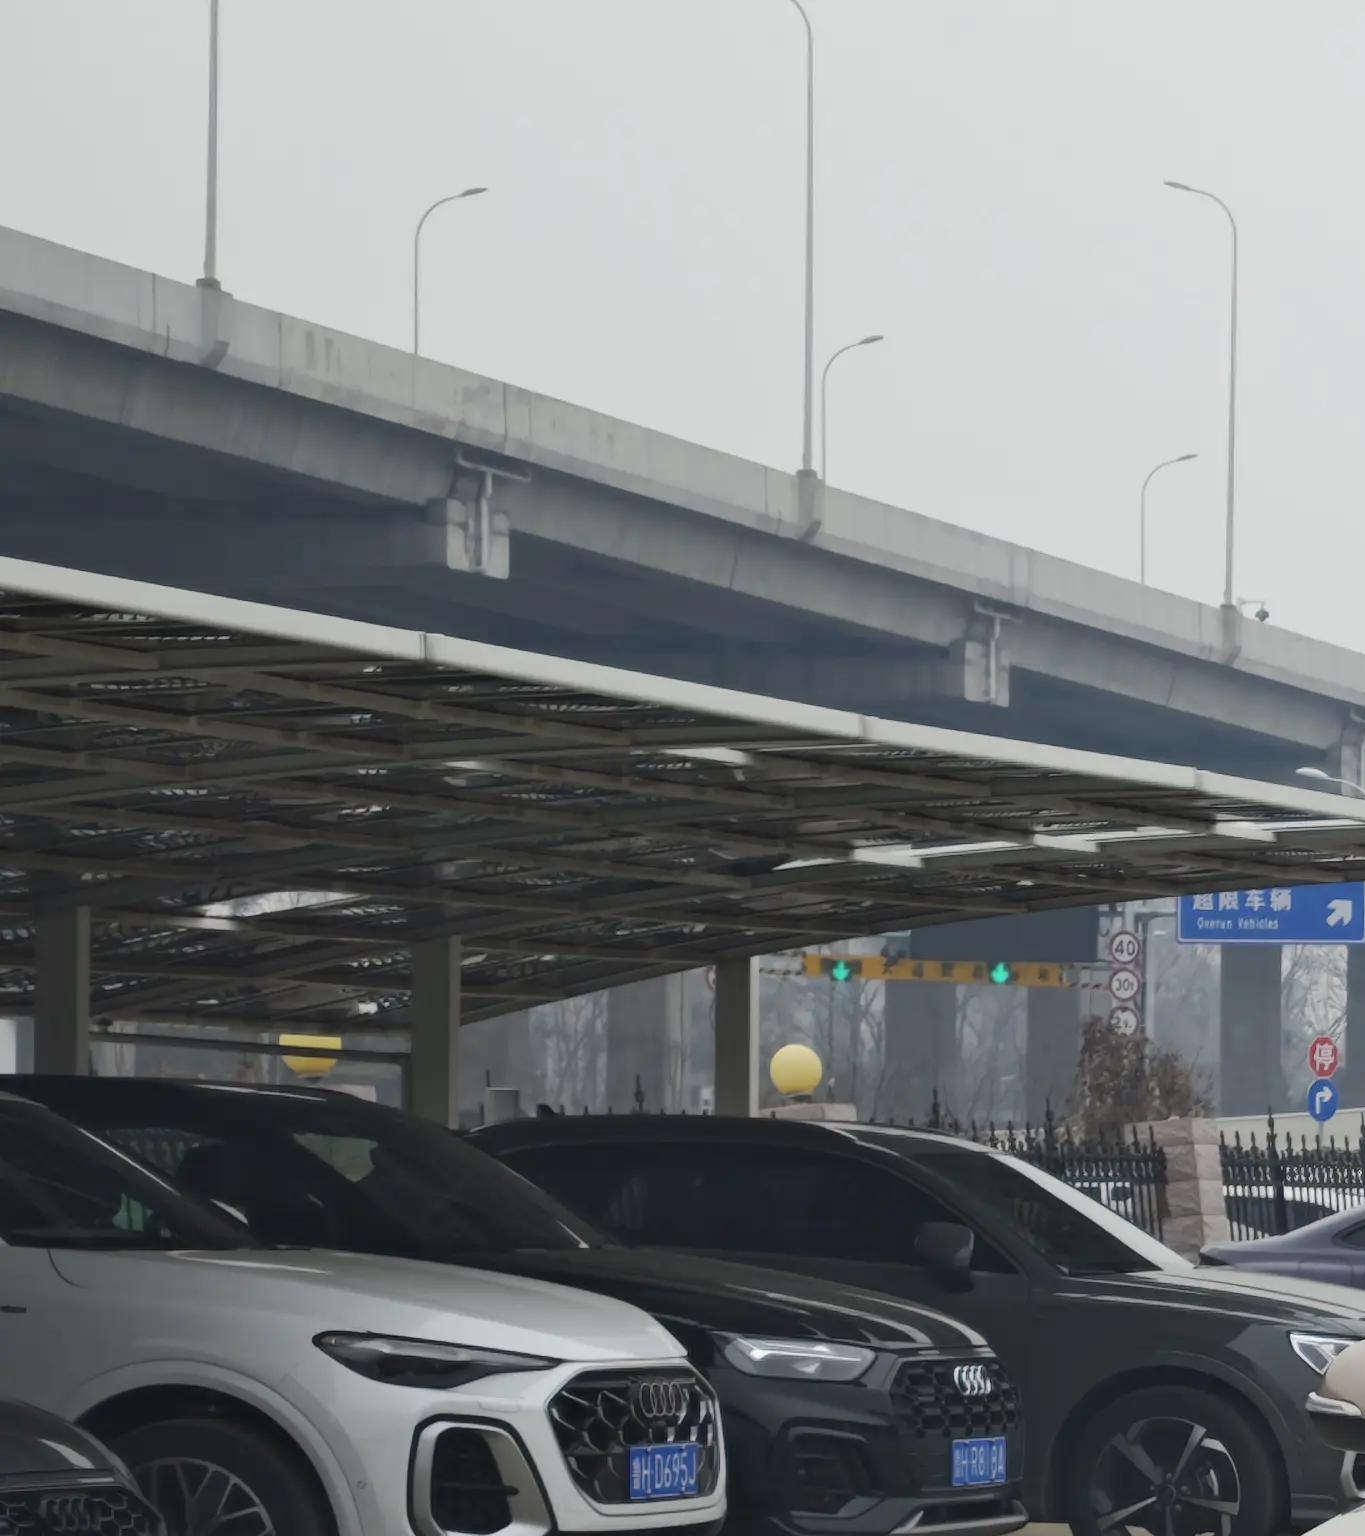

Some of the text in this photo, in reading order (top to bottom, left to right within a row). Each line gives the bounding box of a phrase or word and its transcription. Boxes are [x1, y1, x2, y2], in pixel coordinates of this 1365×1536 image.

[1238, 917, 1279, 930] Vehicles
[1114, 939, 1136, 957] 40
[1115, 978, 1135, 992] 30t
[1313, 1043, 1335, 1071] 停
